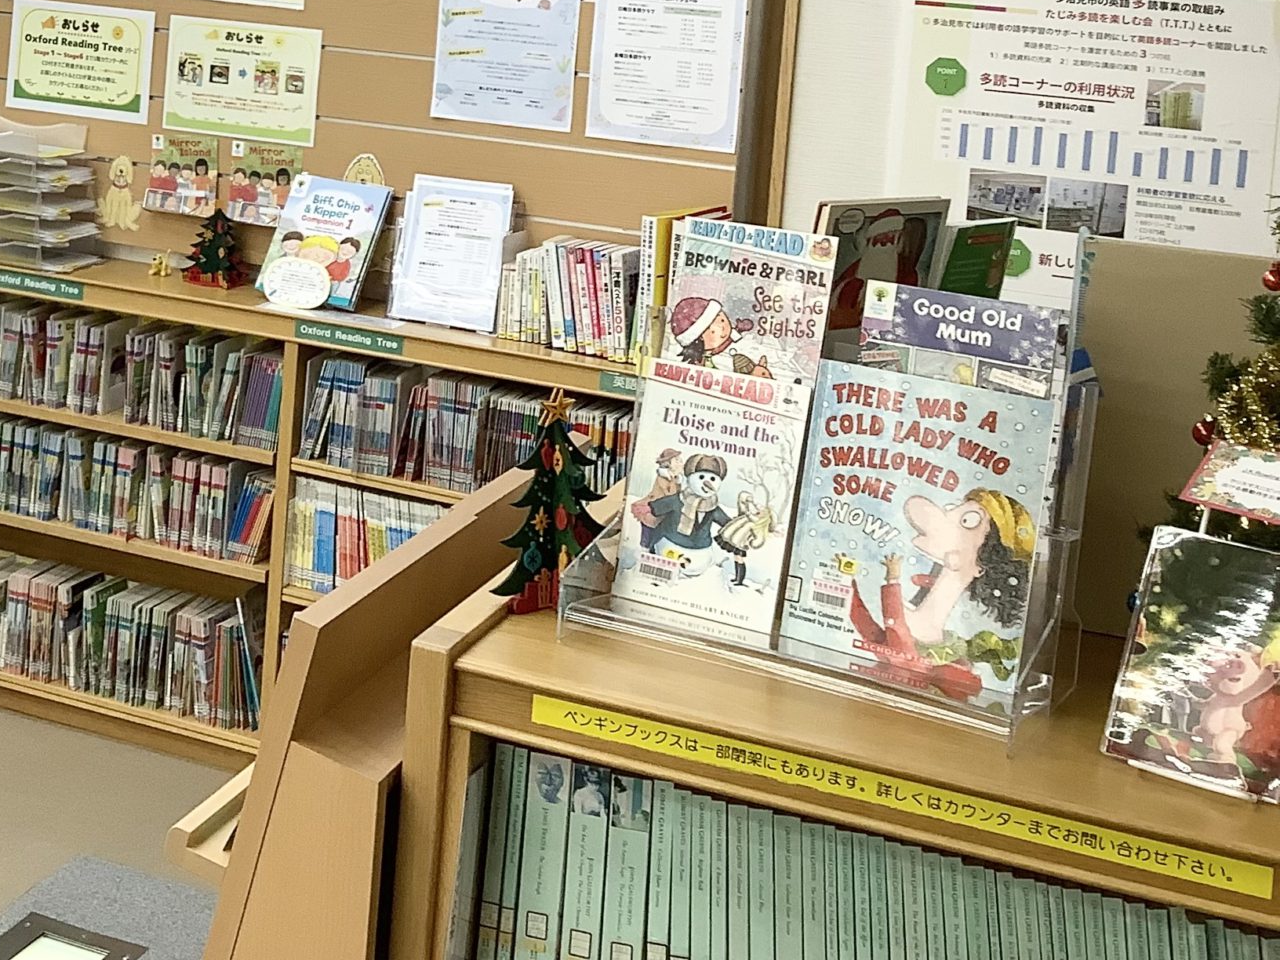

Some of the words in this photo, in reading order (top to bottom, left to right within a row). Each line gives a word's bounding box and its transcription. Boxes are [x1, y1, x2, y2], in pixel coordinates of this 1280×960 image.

[61, 18, 100, 33] おしらせ
[24, 33, 58, 46] Oxford
[61, 37, 99, 52] Reading
[102, 42, 124, 53] Tree
[225, 31, 264, 45] おしらせ
[936, 66, 957, 76] POINT
[980, 72, 1136, 101] 多読コーナーの利用状況
[1037, 100, 1096, 114] 多読資料の収集
[168, 138, 203, 149] Mirror
[179, 146, 212, 158] Island
[249, 145, 285, 157] Mirror
[260, 155, 296, 168] Island
[303, 204, 311, 215] &
[313, 204, 349, 220] Kipper
[336, 198, 361, 213] Chip
[301, 214, 344, 228] Companion
[345, 218, 353, 231] 1
[689, 219, 723, 239] READY
[728, 223, 746, 244] TO
[753, 228, 804, 258] READ
[759, 262, 774, 280] &
[24, 276, 56, 292] Reading
[60, 283, 79, 295] Tree
[752, 286, 783, 314] See
[790, 291, 824, 317] the
[912, 297, 977, 326] Good
[983, 306, 1023, 332] Old
[300, 324, 330, 338] Oxford
[335, 329, 372, 347] Reading
[376, 336, 398, 349] Tree
[936, 325, 992, 349] Mum
[654, 362, 690, 385] READY
[694, 369, 713, 390] TO
[720, 375, 774, 406] READ
[671, 398, 687, 408] KAY
[832, 383, 904, 414] THERE
[915, 394, 967, 423] WAS
[978, 411, 998, 434] A
[663, 406, 715, 433] Eloise
[720, 424, 750, 439] and
[753, 426, 780, 445] the
[678, 428, 757, 459] Snowman
[824, 414, 884, 439] COLD
[893, 421, 951, 452] LADY
[957, 436, 1011, 475] WHO
[819, 446, 960, 494] SWALLOWED
[832, 473, 898, 503] SOME
[817, 495, 901, 548] SNOW!
[843, 625, 855, 635] Lee
[863, 642, 932, 666] SCHOLASTIC
[564, 709, 1234, 883] ペンギンブックスは一部閉架にもあります。詳しくはカウンターまでお問い合わせ下さい。
